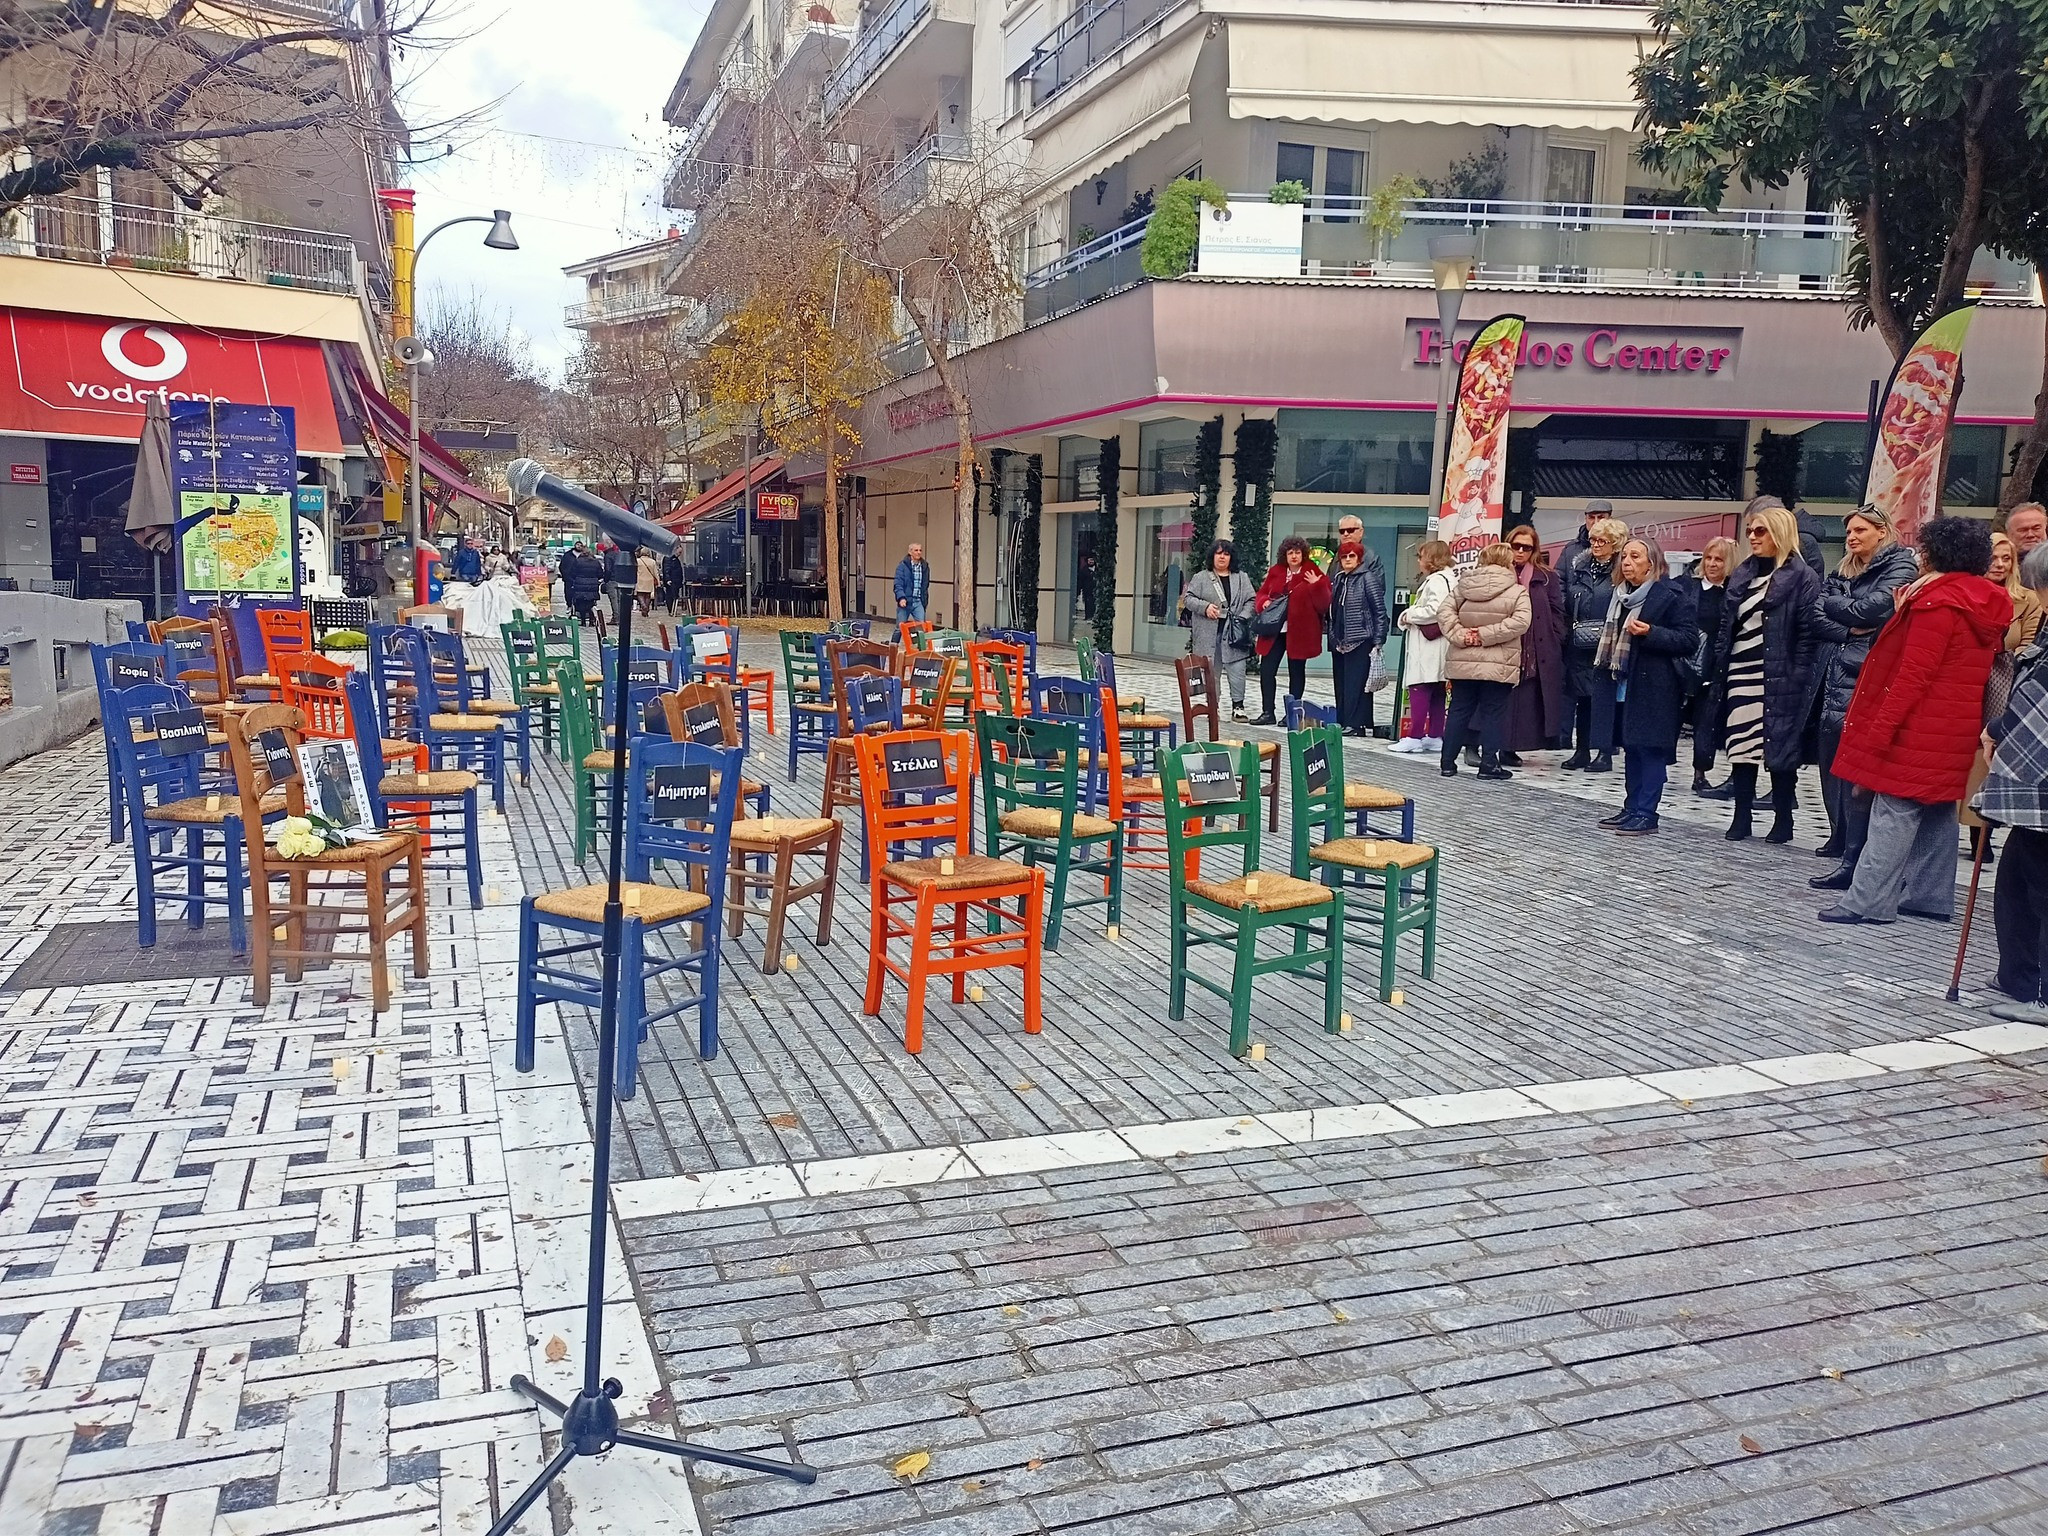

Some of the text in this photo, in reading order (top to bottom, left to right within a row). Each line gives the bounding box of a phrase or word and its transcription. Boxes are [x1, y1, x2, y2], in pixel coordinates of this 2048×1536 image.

[1583, 329, 1732, 372] Center
[761, 495, 795, 506] ΓΥΡΟΣ
[119, 665, 149, 678] Σοφία
[628, 671, 656, 682] έτρος
[913, 669, 939, 679] Κατερίνα
[160, 721, 206, 740] Βασιλική
[892, 756, 939, 773] Στέλλα
[1307, 758, 1327, 776] Ελένη
[1190, 770, 1231, 784] Σπυρίδων
[657, 784, 708, 800] Δήμητρα
